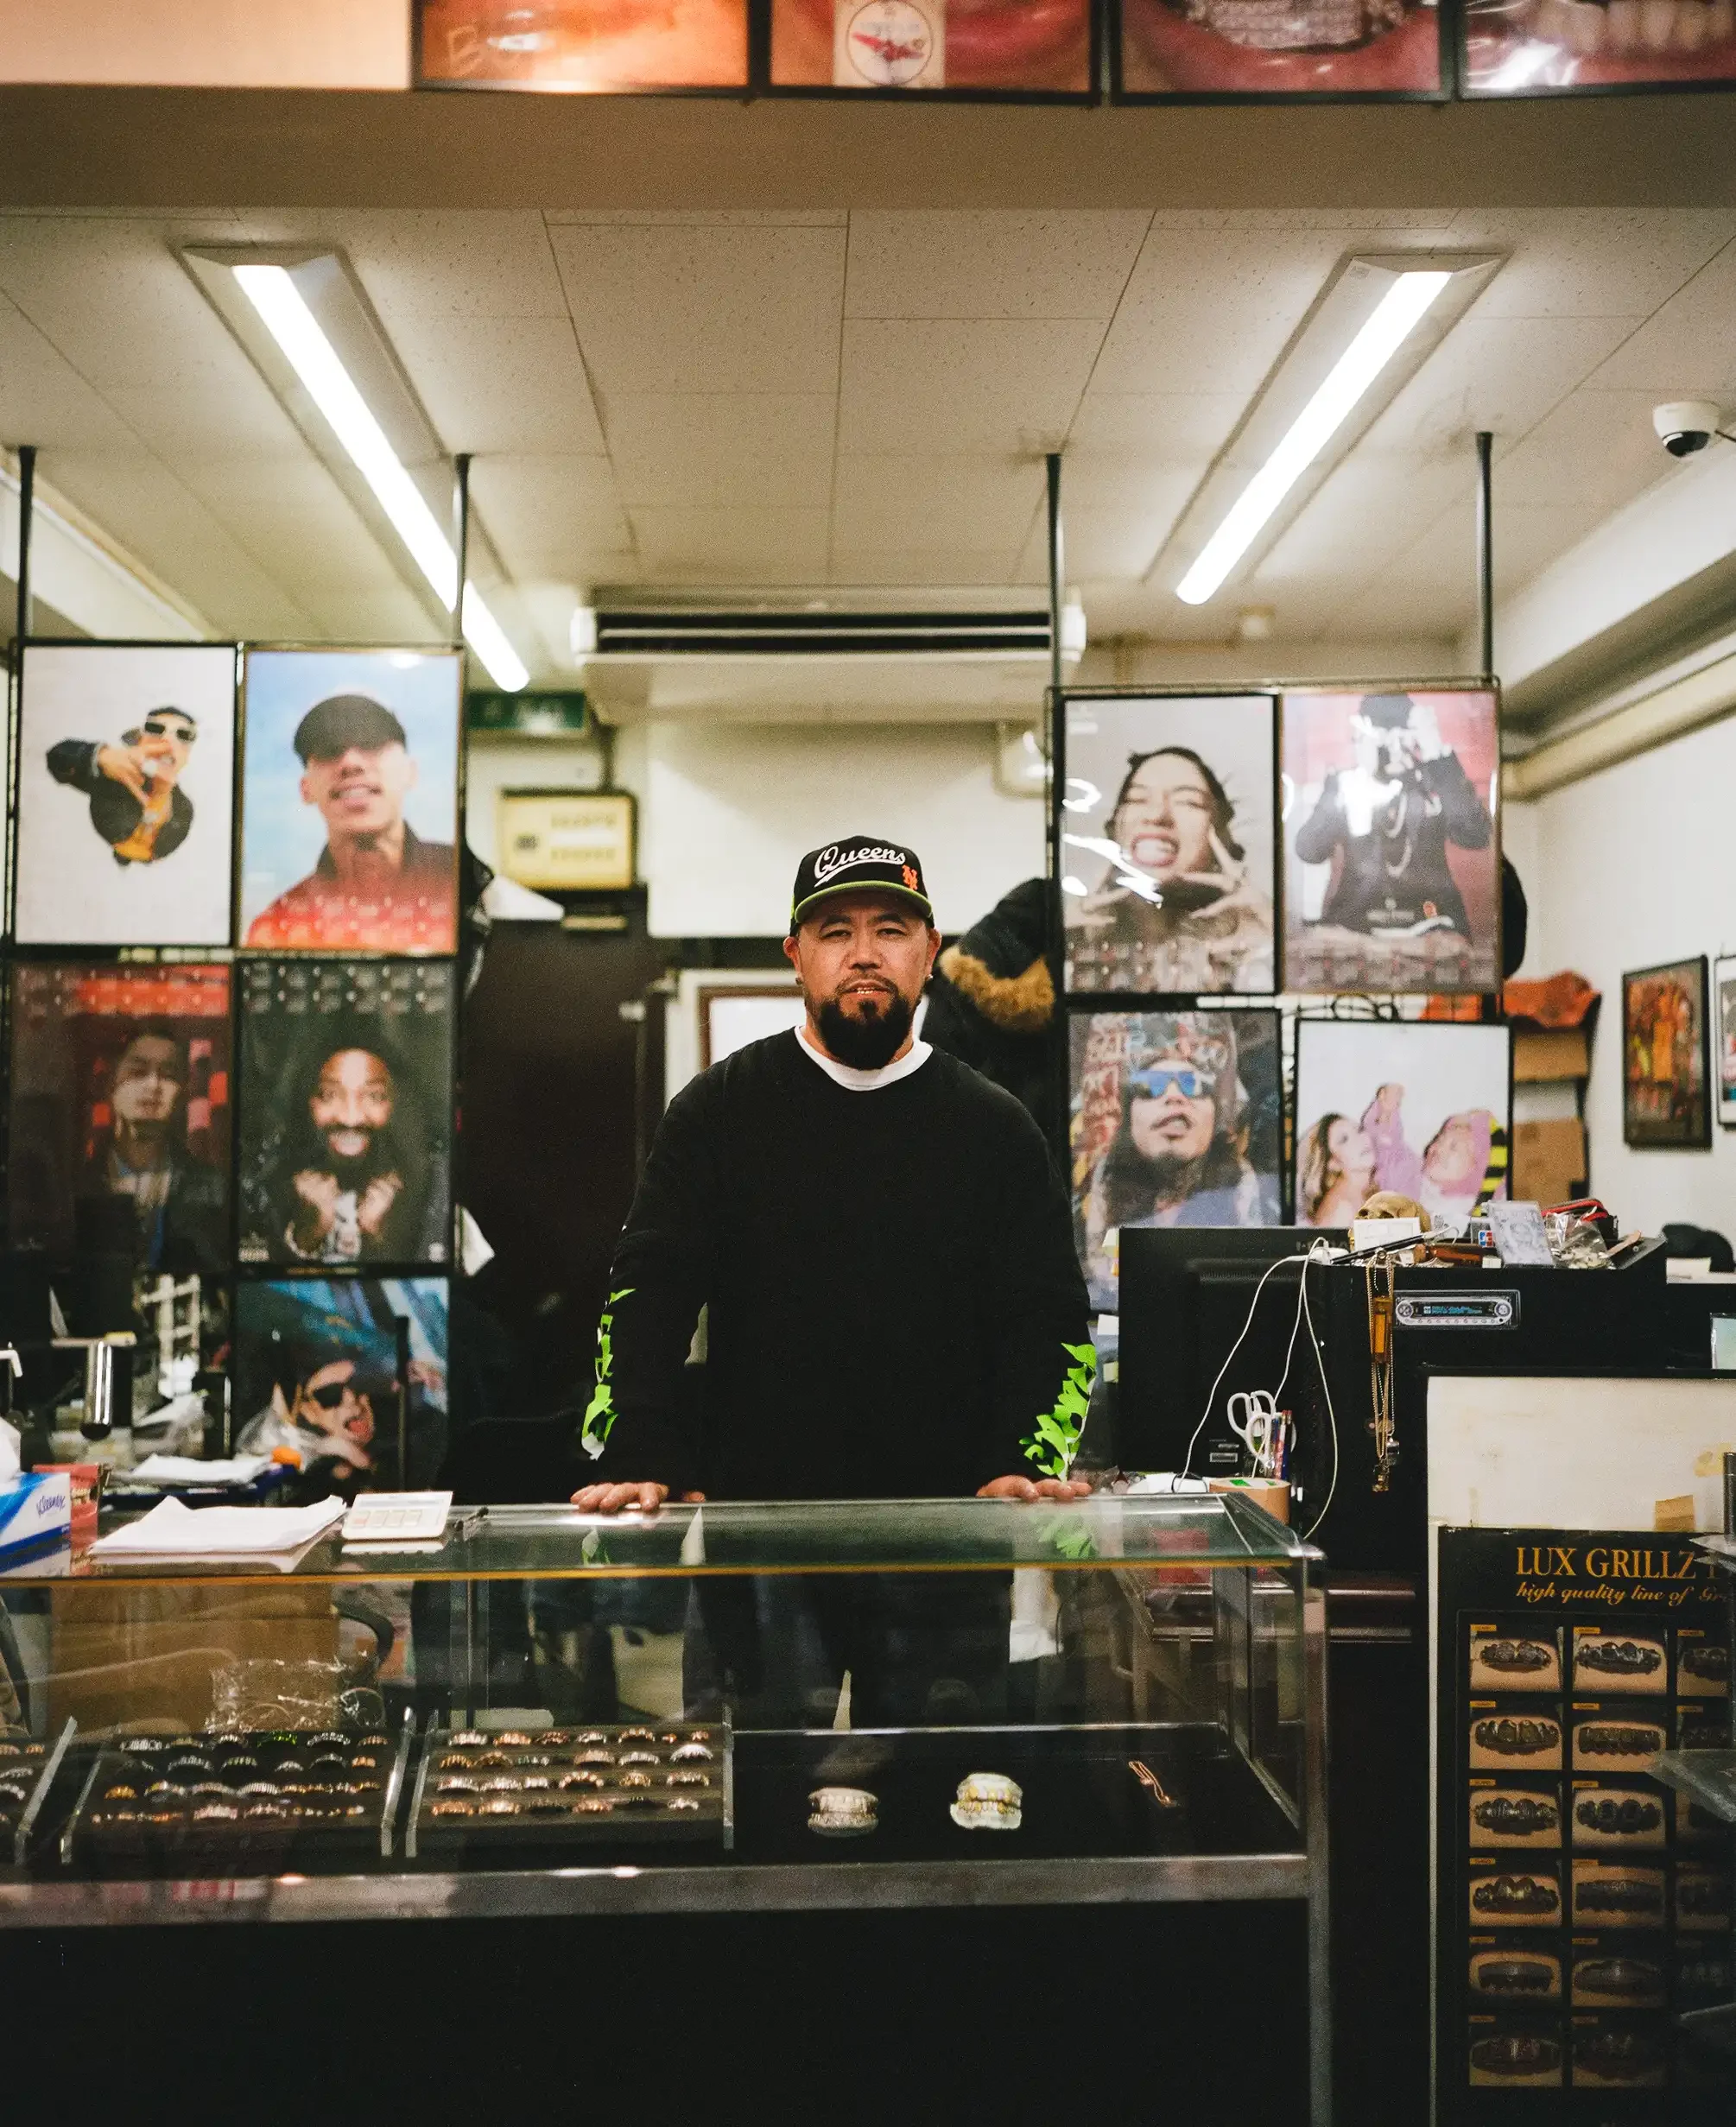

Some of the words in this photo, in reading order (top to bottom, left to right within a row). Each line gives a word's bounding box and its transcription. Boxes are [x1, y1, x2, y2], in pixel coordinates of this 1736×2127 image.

[814, 845, 906, 886] Queens
[1516, 1547, 1578, 1576] LUX
[1586, 1548, 1697, 1579] GRILLZ
[1516, 1581, 1556, 1604] high
[1561, 1583, 1626, 1606] quality
[1631, 1584, 1666, 1602] line
[1669, 1586, 1695, 1607] of
